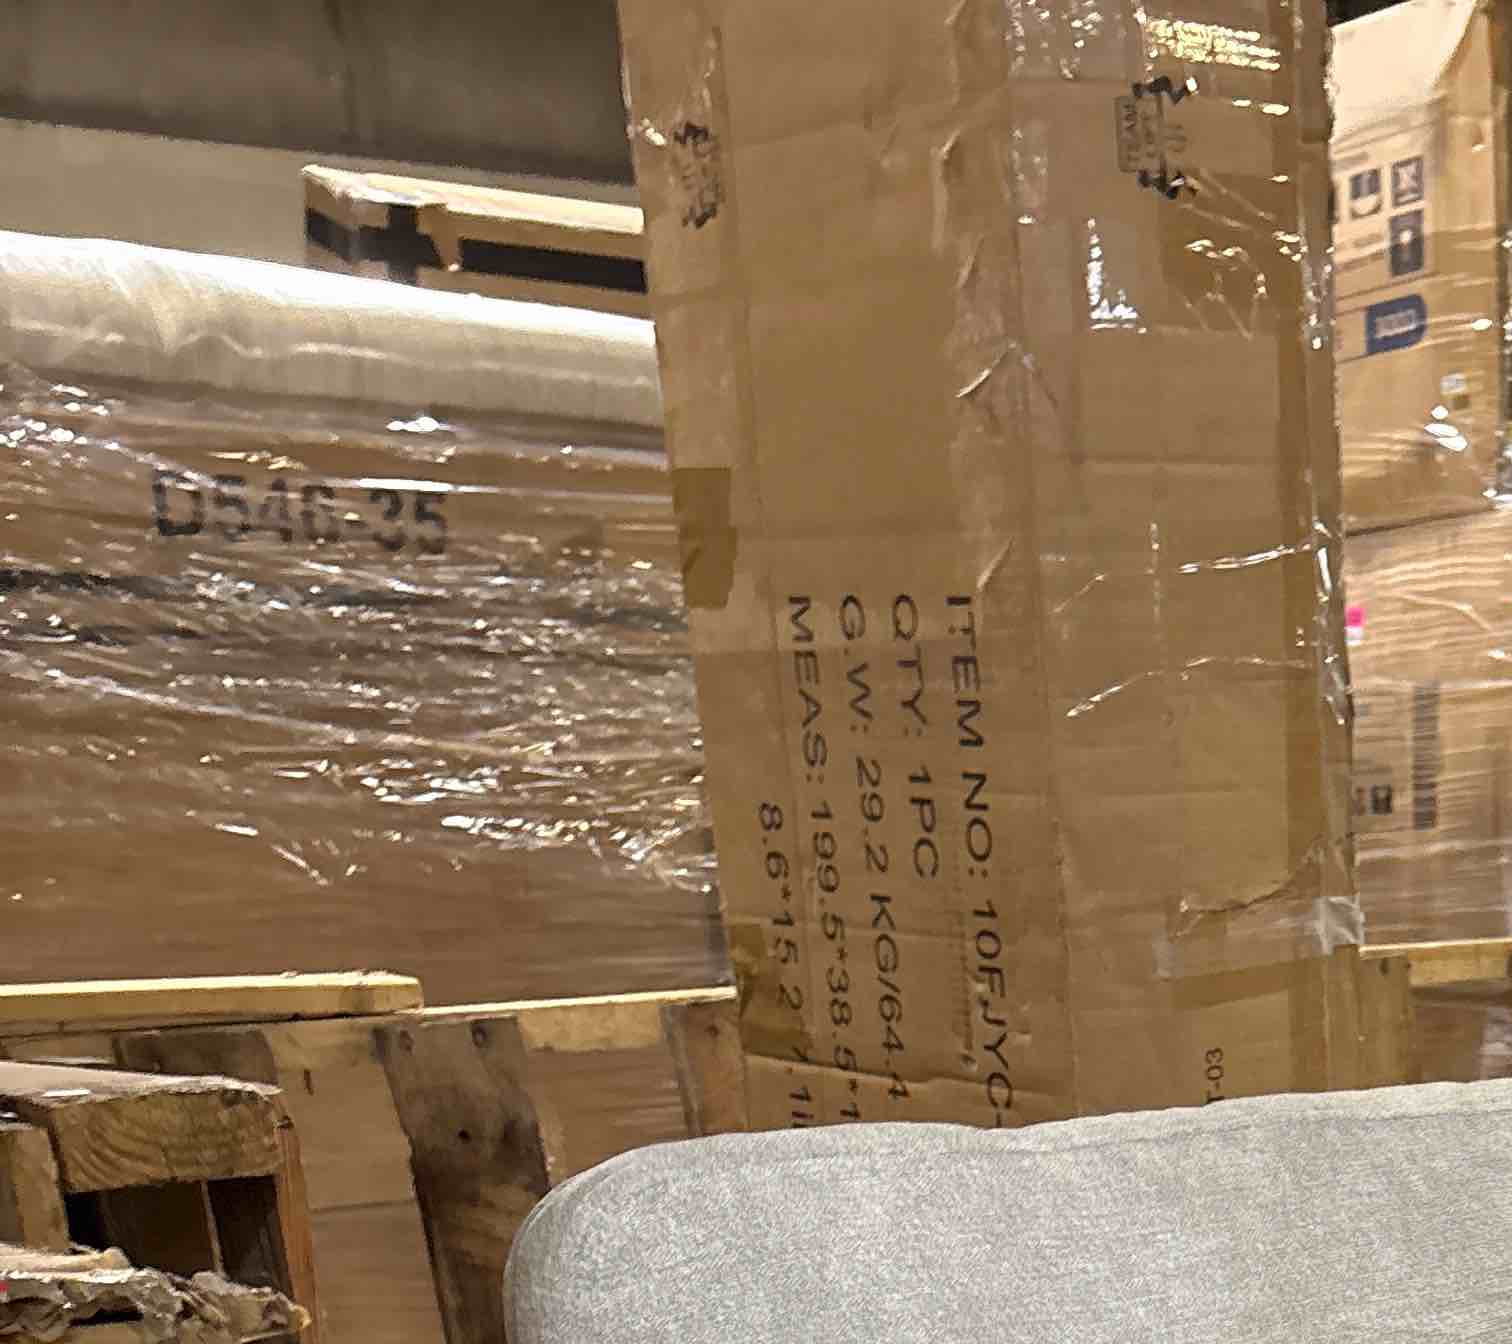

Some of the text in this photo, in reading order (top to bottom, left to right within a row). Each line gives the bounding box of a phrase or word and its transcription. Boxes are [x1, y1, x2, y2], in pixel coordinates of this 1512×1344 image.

[788, 596, 829, 783] MEAS:
[839, 595, 873, 736] G.W:
[856, 758, 890, 874] 29.2
[892, 594, 940, 879] QTY: 1PC
[945, 594, 986, 751] ITEM
[959, 772, 995, 879] NO:
